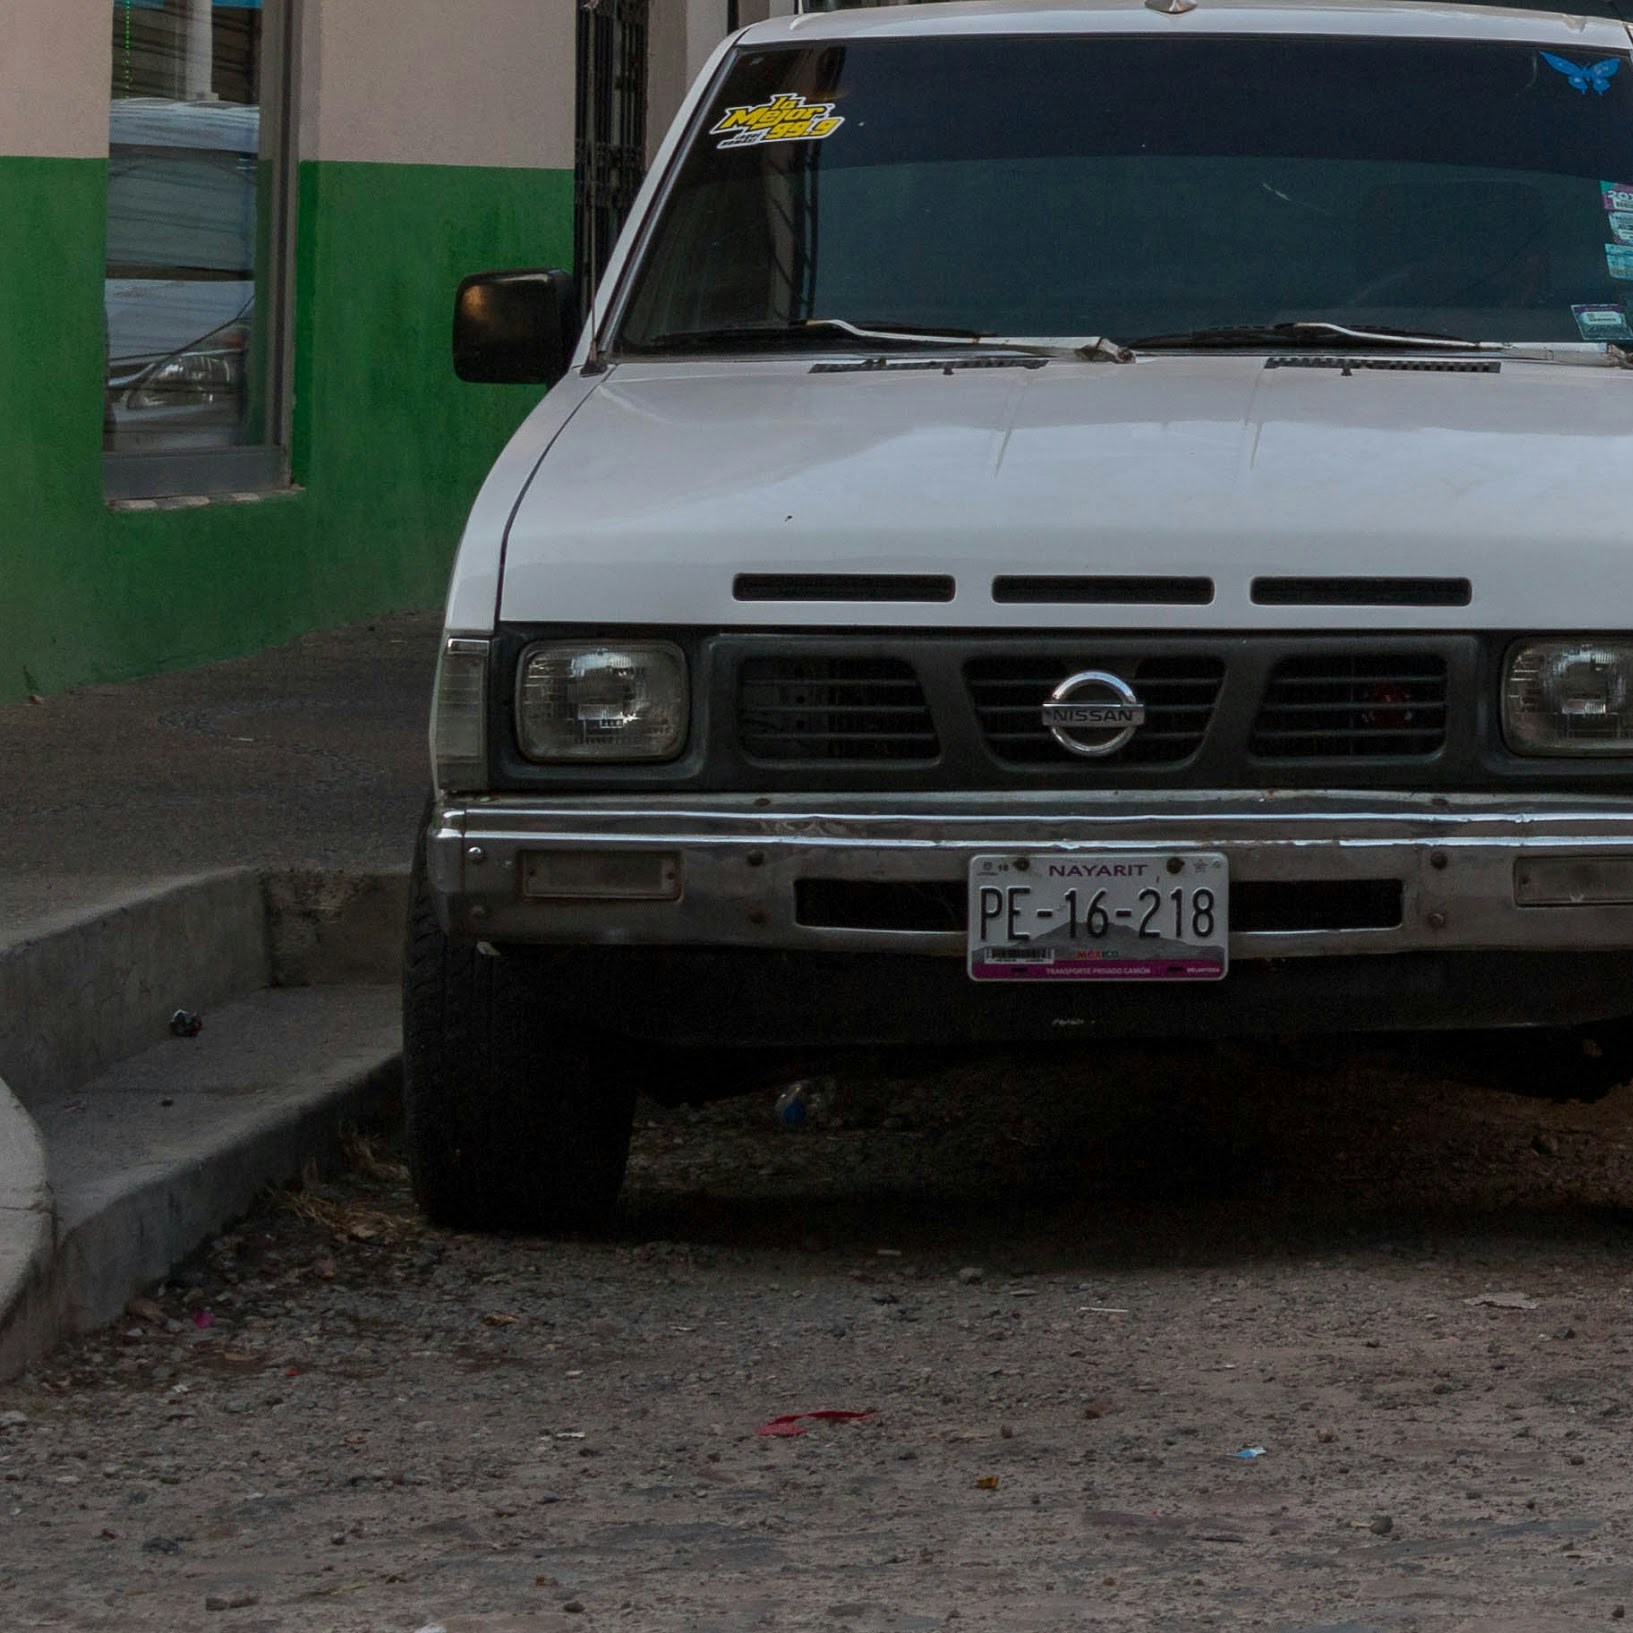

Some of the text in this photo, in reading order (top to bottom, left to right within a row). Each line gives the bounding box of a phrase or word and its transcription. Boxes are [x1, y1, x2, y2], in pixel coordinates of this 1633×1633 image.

[1053, 709, 1132, 722] NISSAN
[1049, 863, 1148, 878] NAYARIT
[979, 886, 1216, 942] PE-16-218
